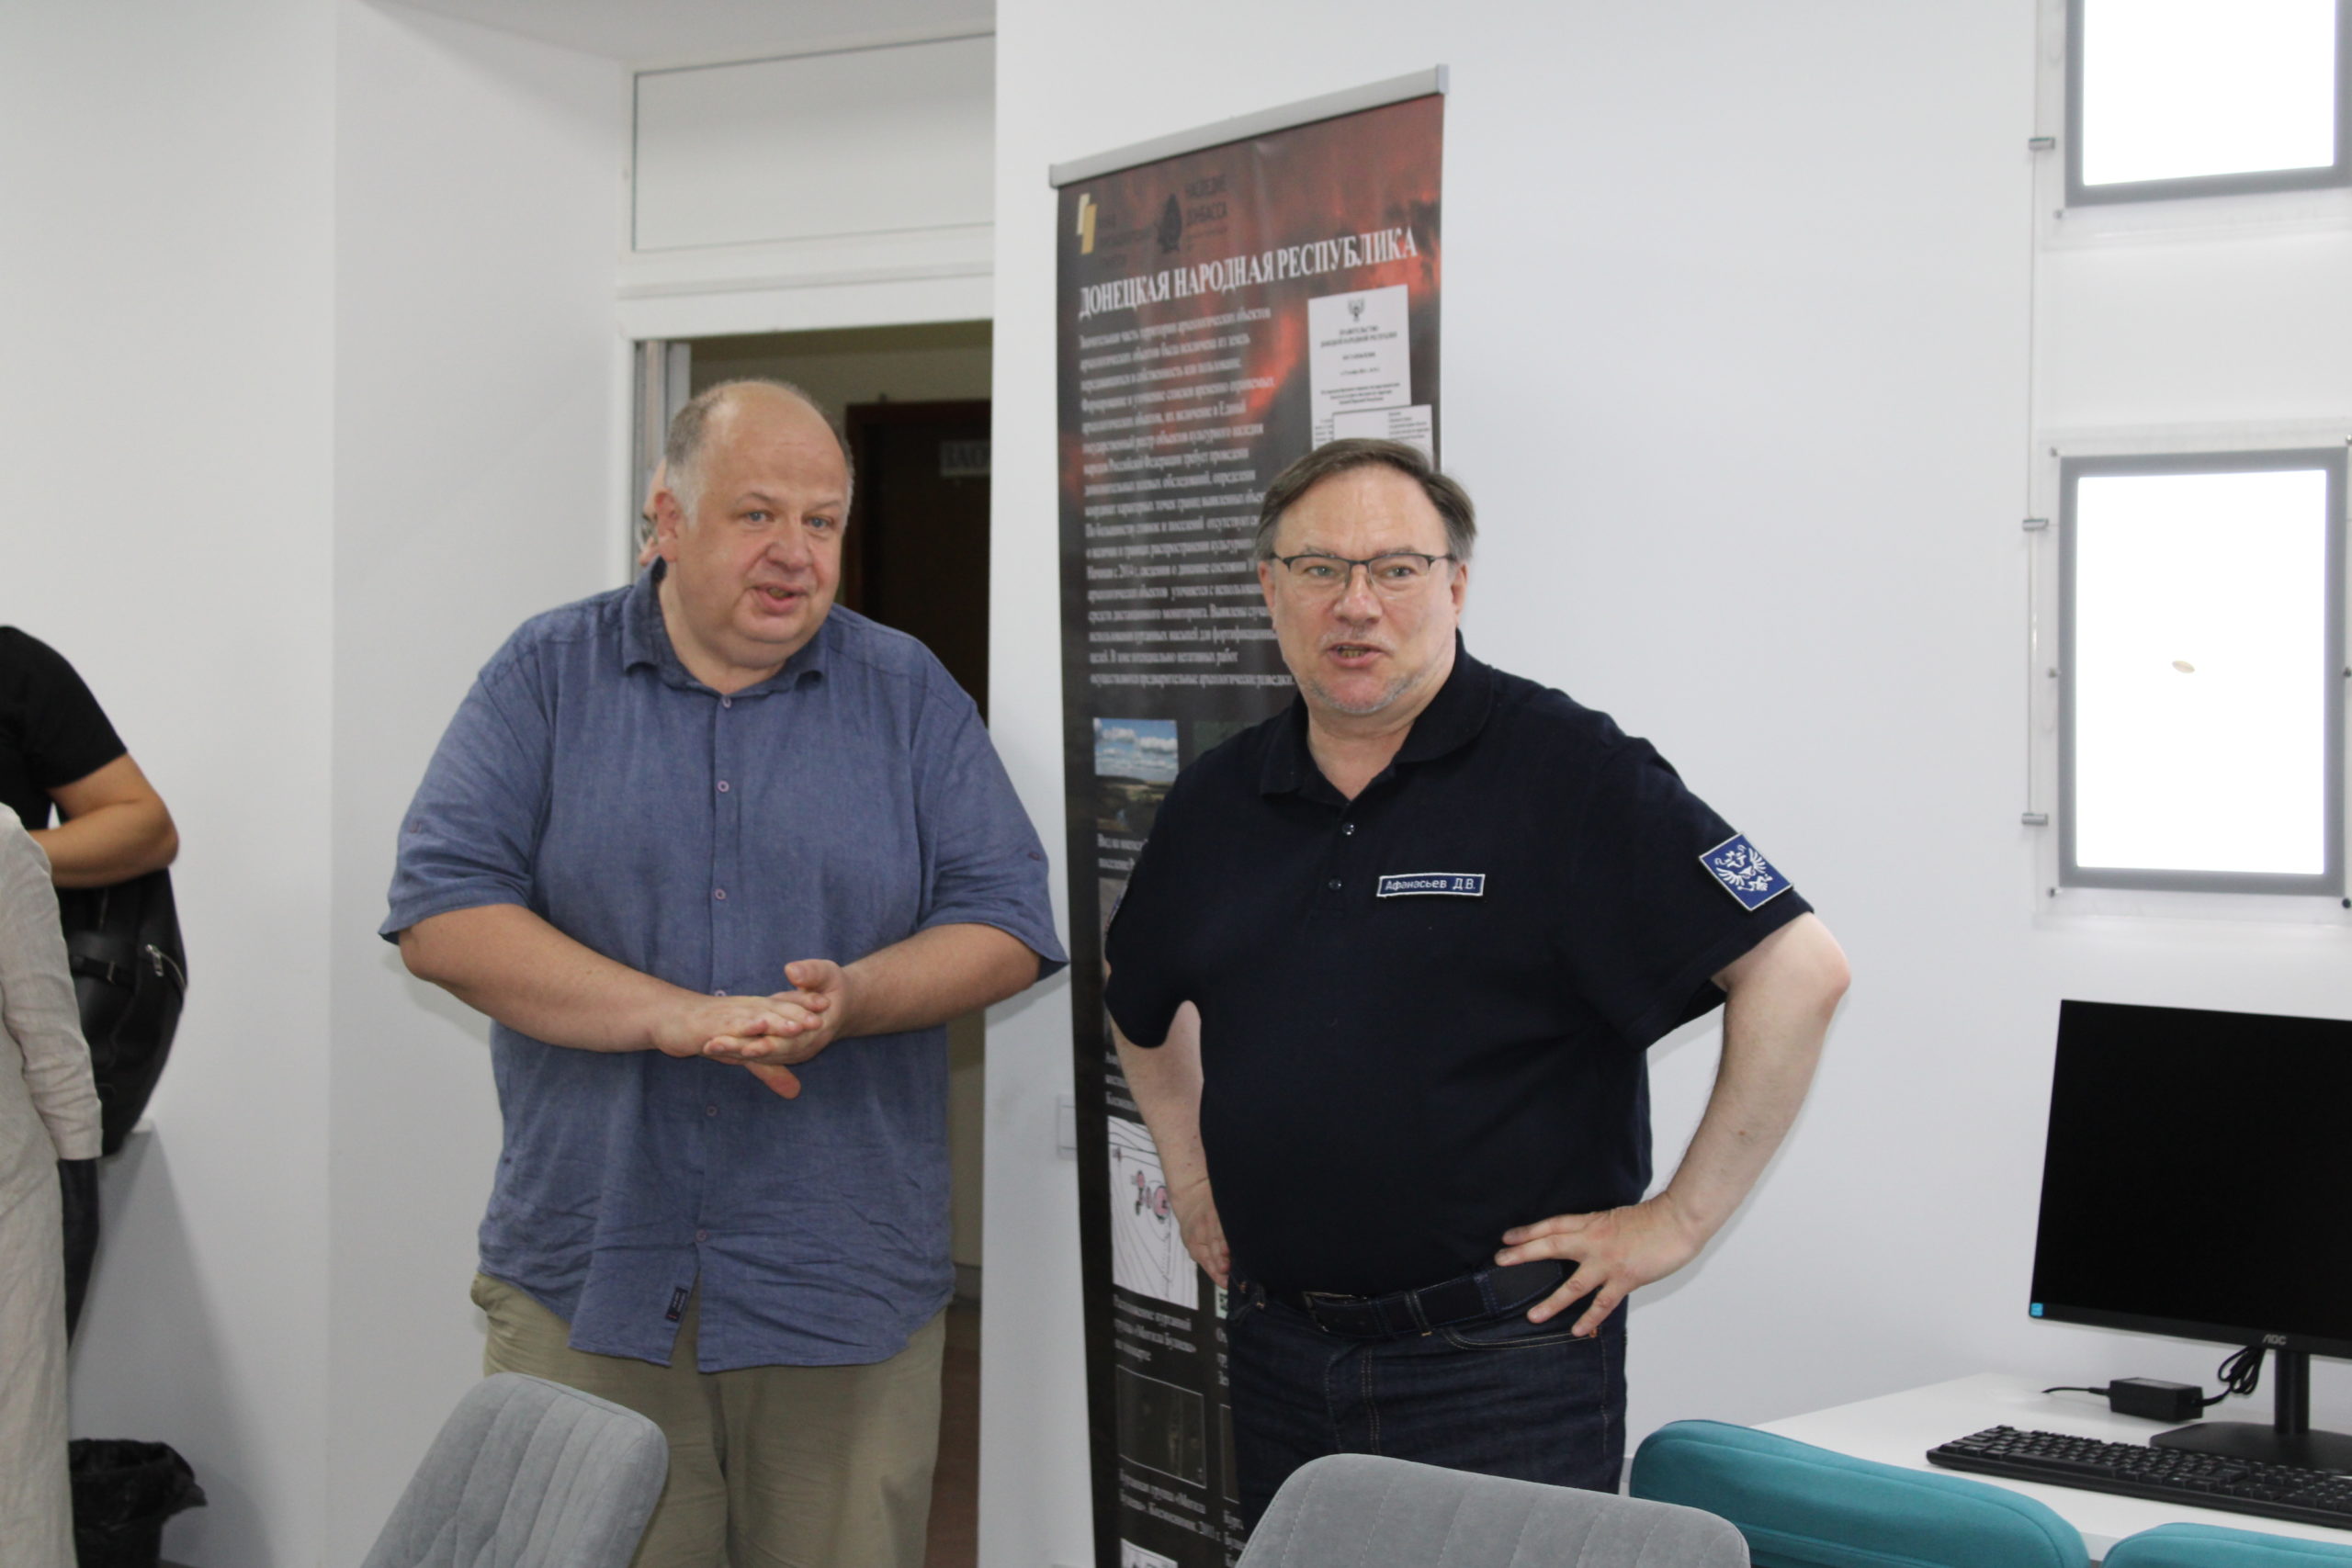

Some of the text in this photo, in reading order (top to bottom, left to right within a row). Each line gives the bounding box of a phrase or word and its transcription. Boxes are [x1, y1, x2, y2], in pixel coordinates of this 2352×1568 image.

[1079, 224, 1419, 321] ДОНЕЦКАЯ НАРОДНАЯ РЕСПУБЛИКА
[1385, 879, 1447, 892] Афанасьев
[2262, 1334, 2287, 1346] AOC
